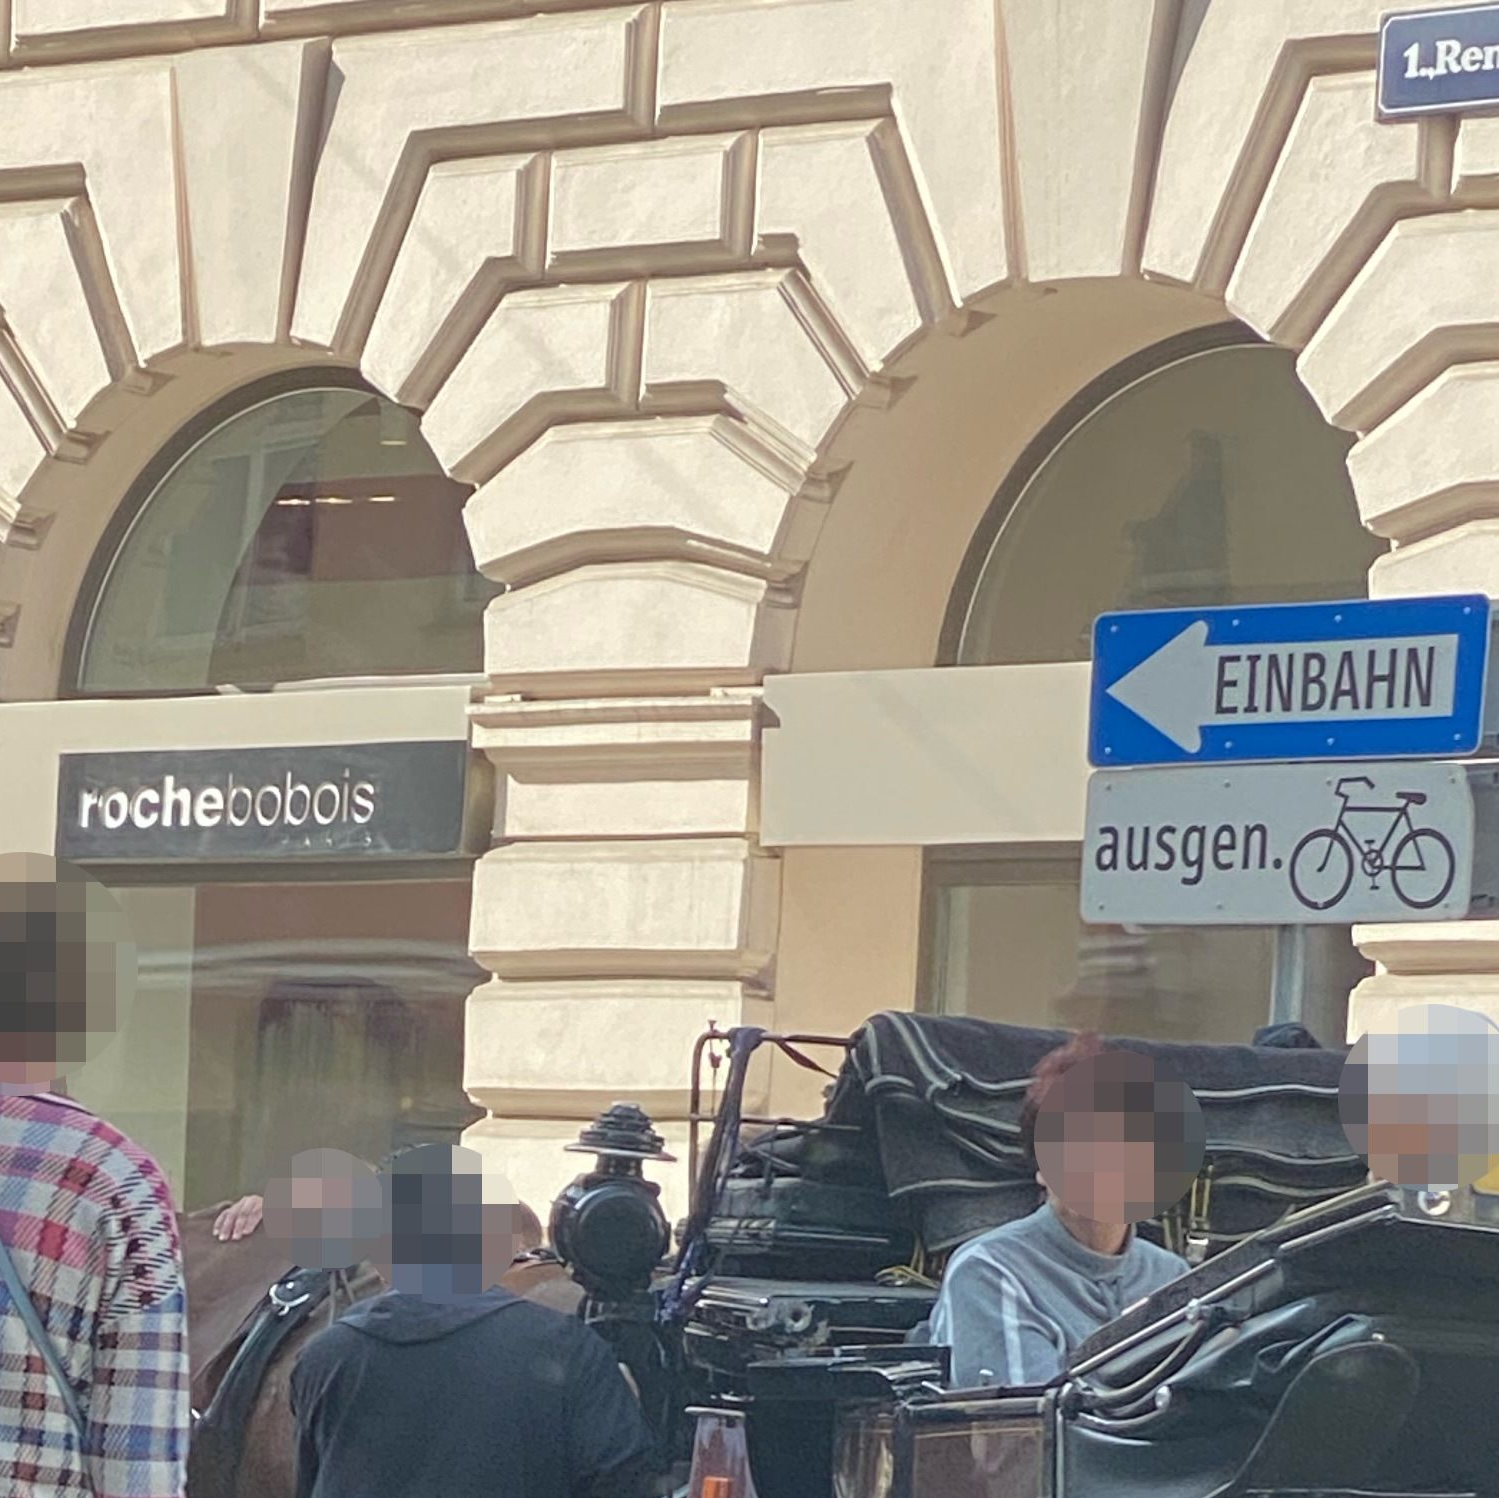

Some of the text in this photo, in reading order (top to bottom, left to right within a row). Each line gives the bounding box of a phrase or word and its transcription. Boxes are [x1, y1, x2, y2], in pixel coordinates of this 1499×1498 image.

[1215, 646, 1436, 715] EINBAHN
[78, 767, 376, 829] rochebobois
[1095, 822, 1284, 886] ausgen.
